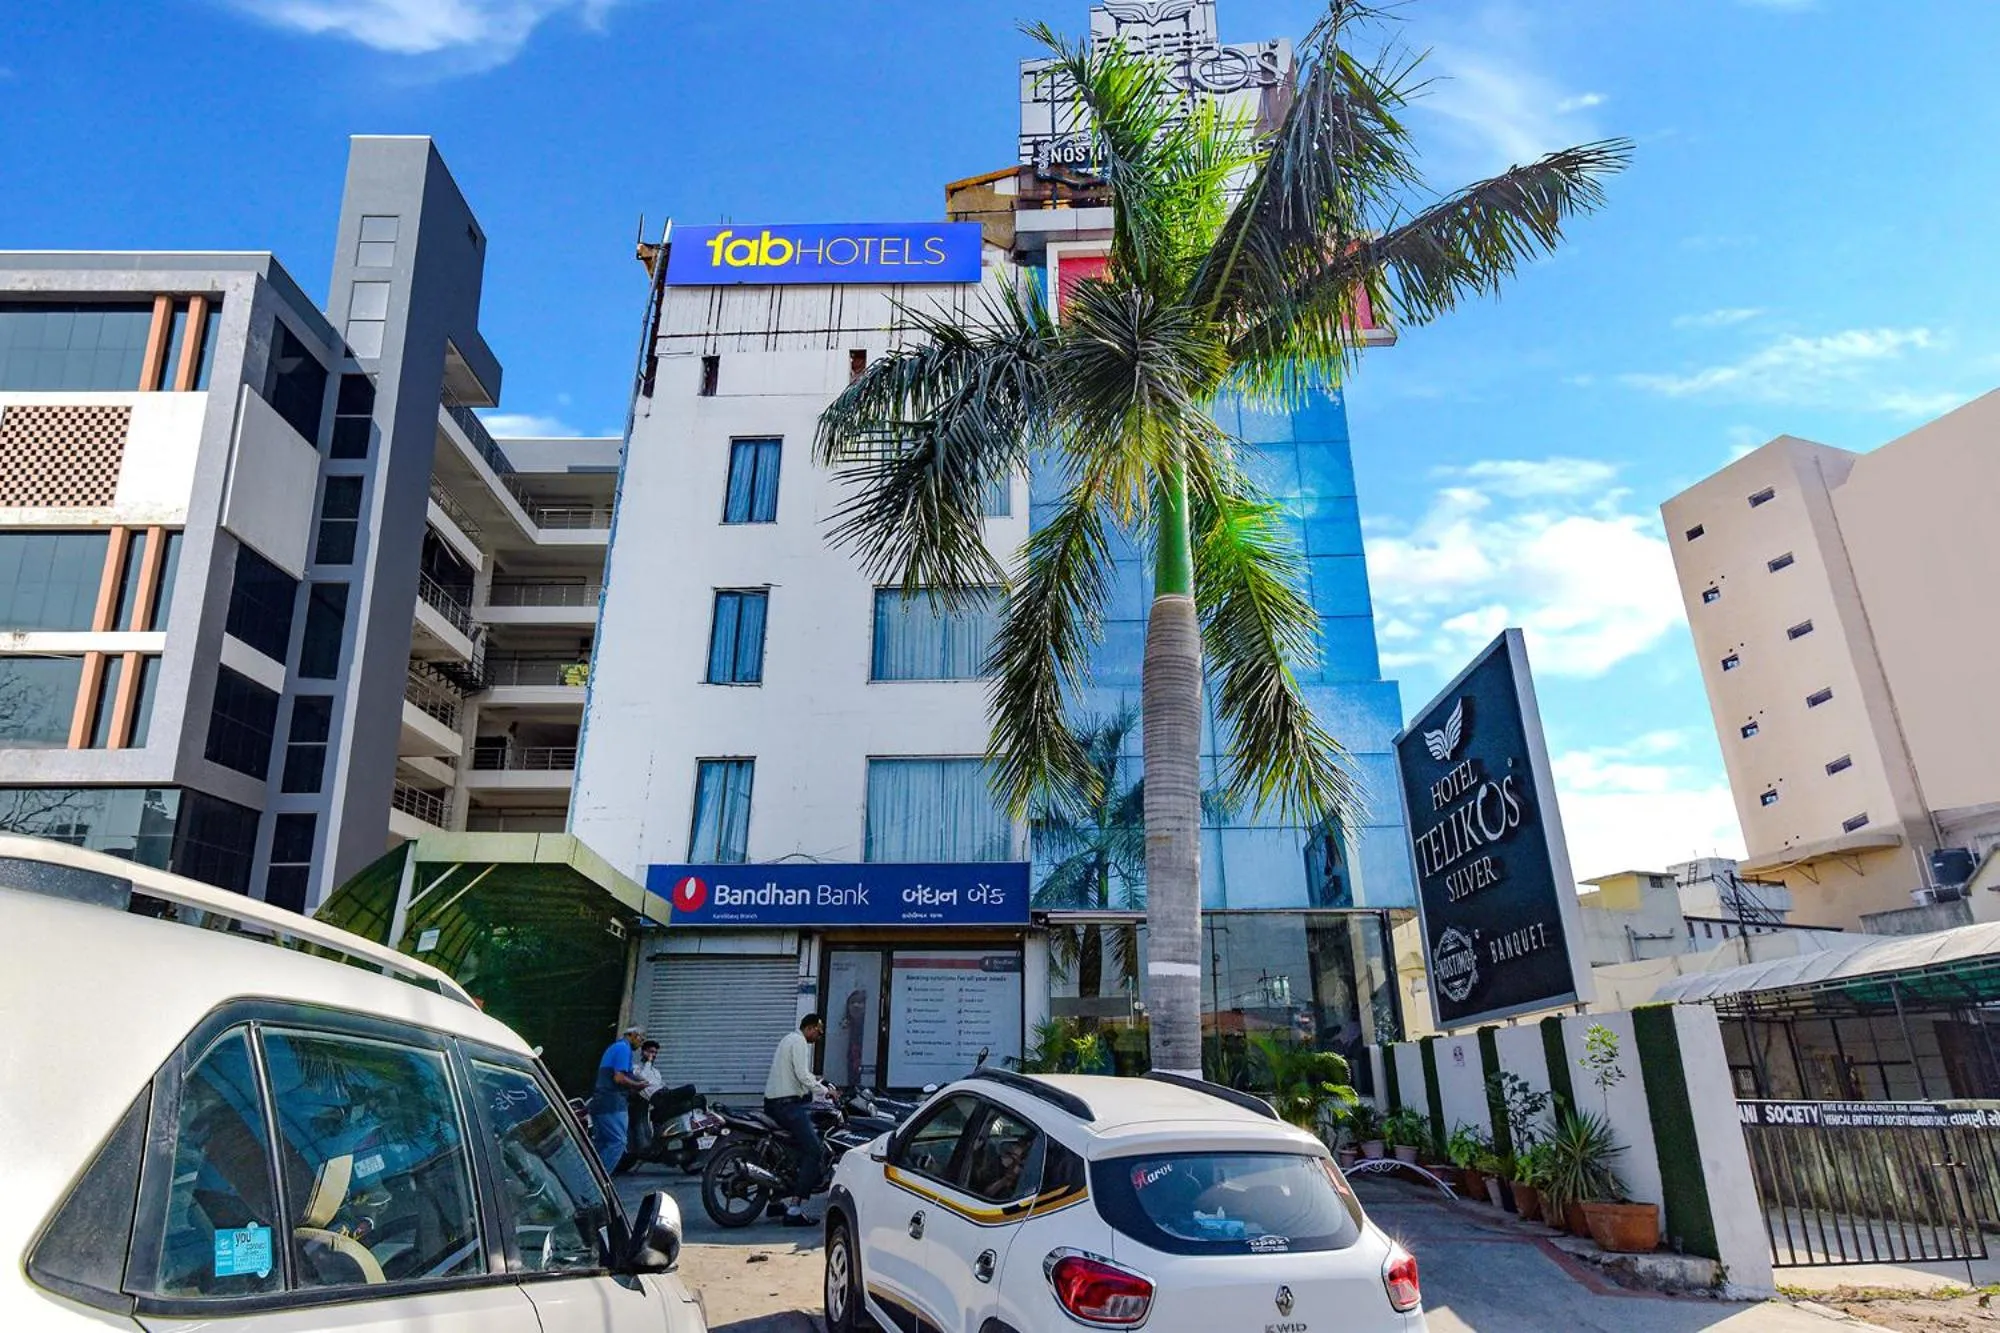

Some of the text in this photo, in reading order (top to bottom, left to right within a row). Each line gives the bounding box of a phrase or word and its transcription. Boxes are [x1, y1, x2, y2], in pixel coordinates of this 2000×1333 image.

[1430, 759, 1478, 811] HOTEL
[1416, 775, 1520, 878] TELIKOS
[1446, 856, 1498, 902] SILVER
[714, 882, 869, 905] Bandhan Bank
[902, 883, 1006, 906] બંધન બેંક
[1489, 922, 1546, 964] BANQUET
[1438, 949, 1474, 979] NOSTIMO
[1765, 1104, 1818, 1124] SOCIETY
[235, 1231, 252, 1247] you
[1264, 1322, 1308, 1333] KWID
